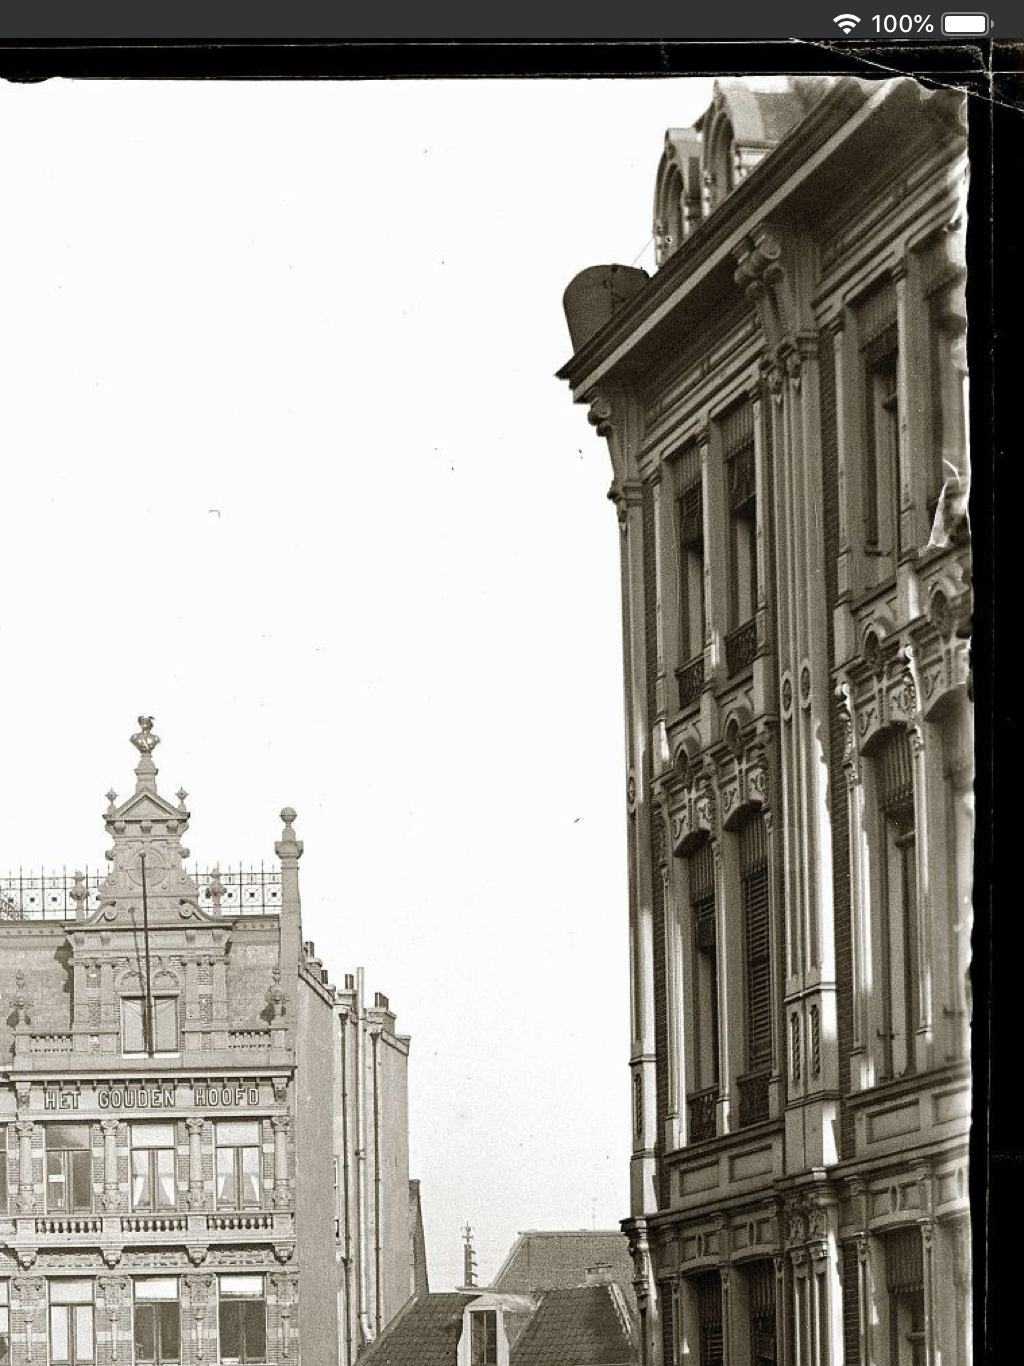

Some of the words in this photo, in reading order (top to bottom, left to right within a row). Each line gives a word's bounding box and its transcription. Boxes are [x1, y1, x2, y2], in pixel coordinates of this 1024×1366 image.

[44, 1088, 81, 1109] HET
[97, 1088, 176, 1109] GOUDEN
[193, 1087, 260, 1107] HOOFD
